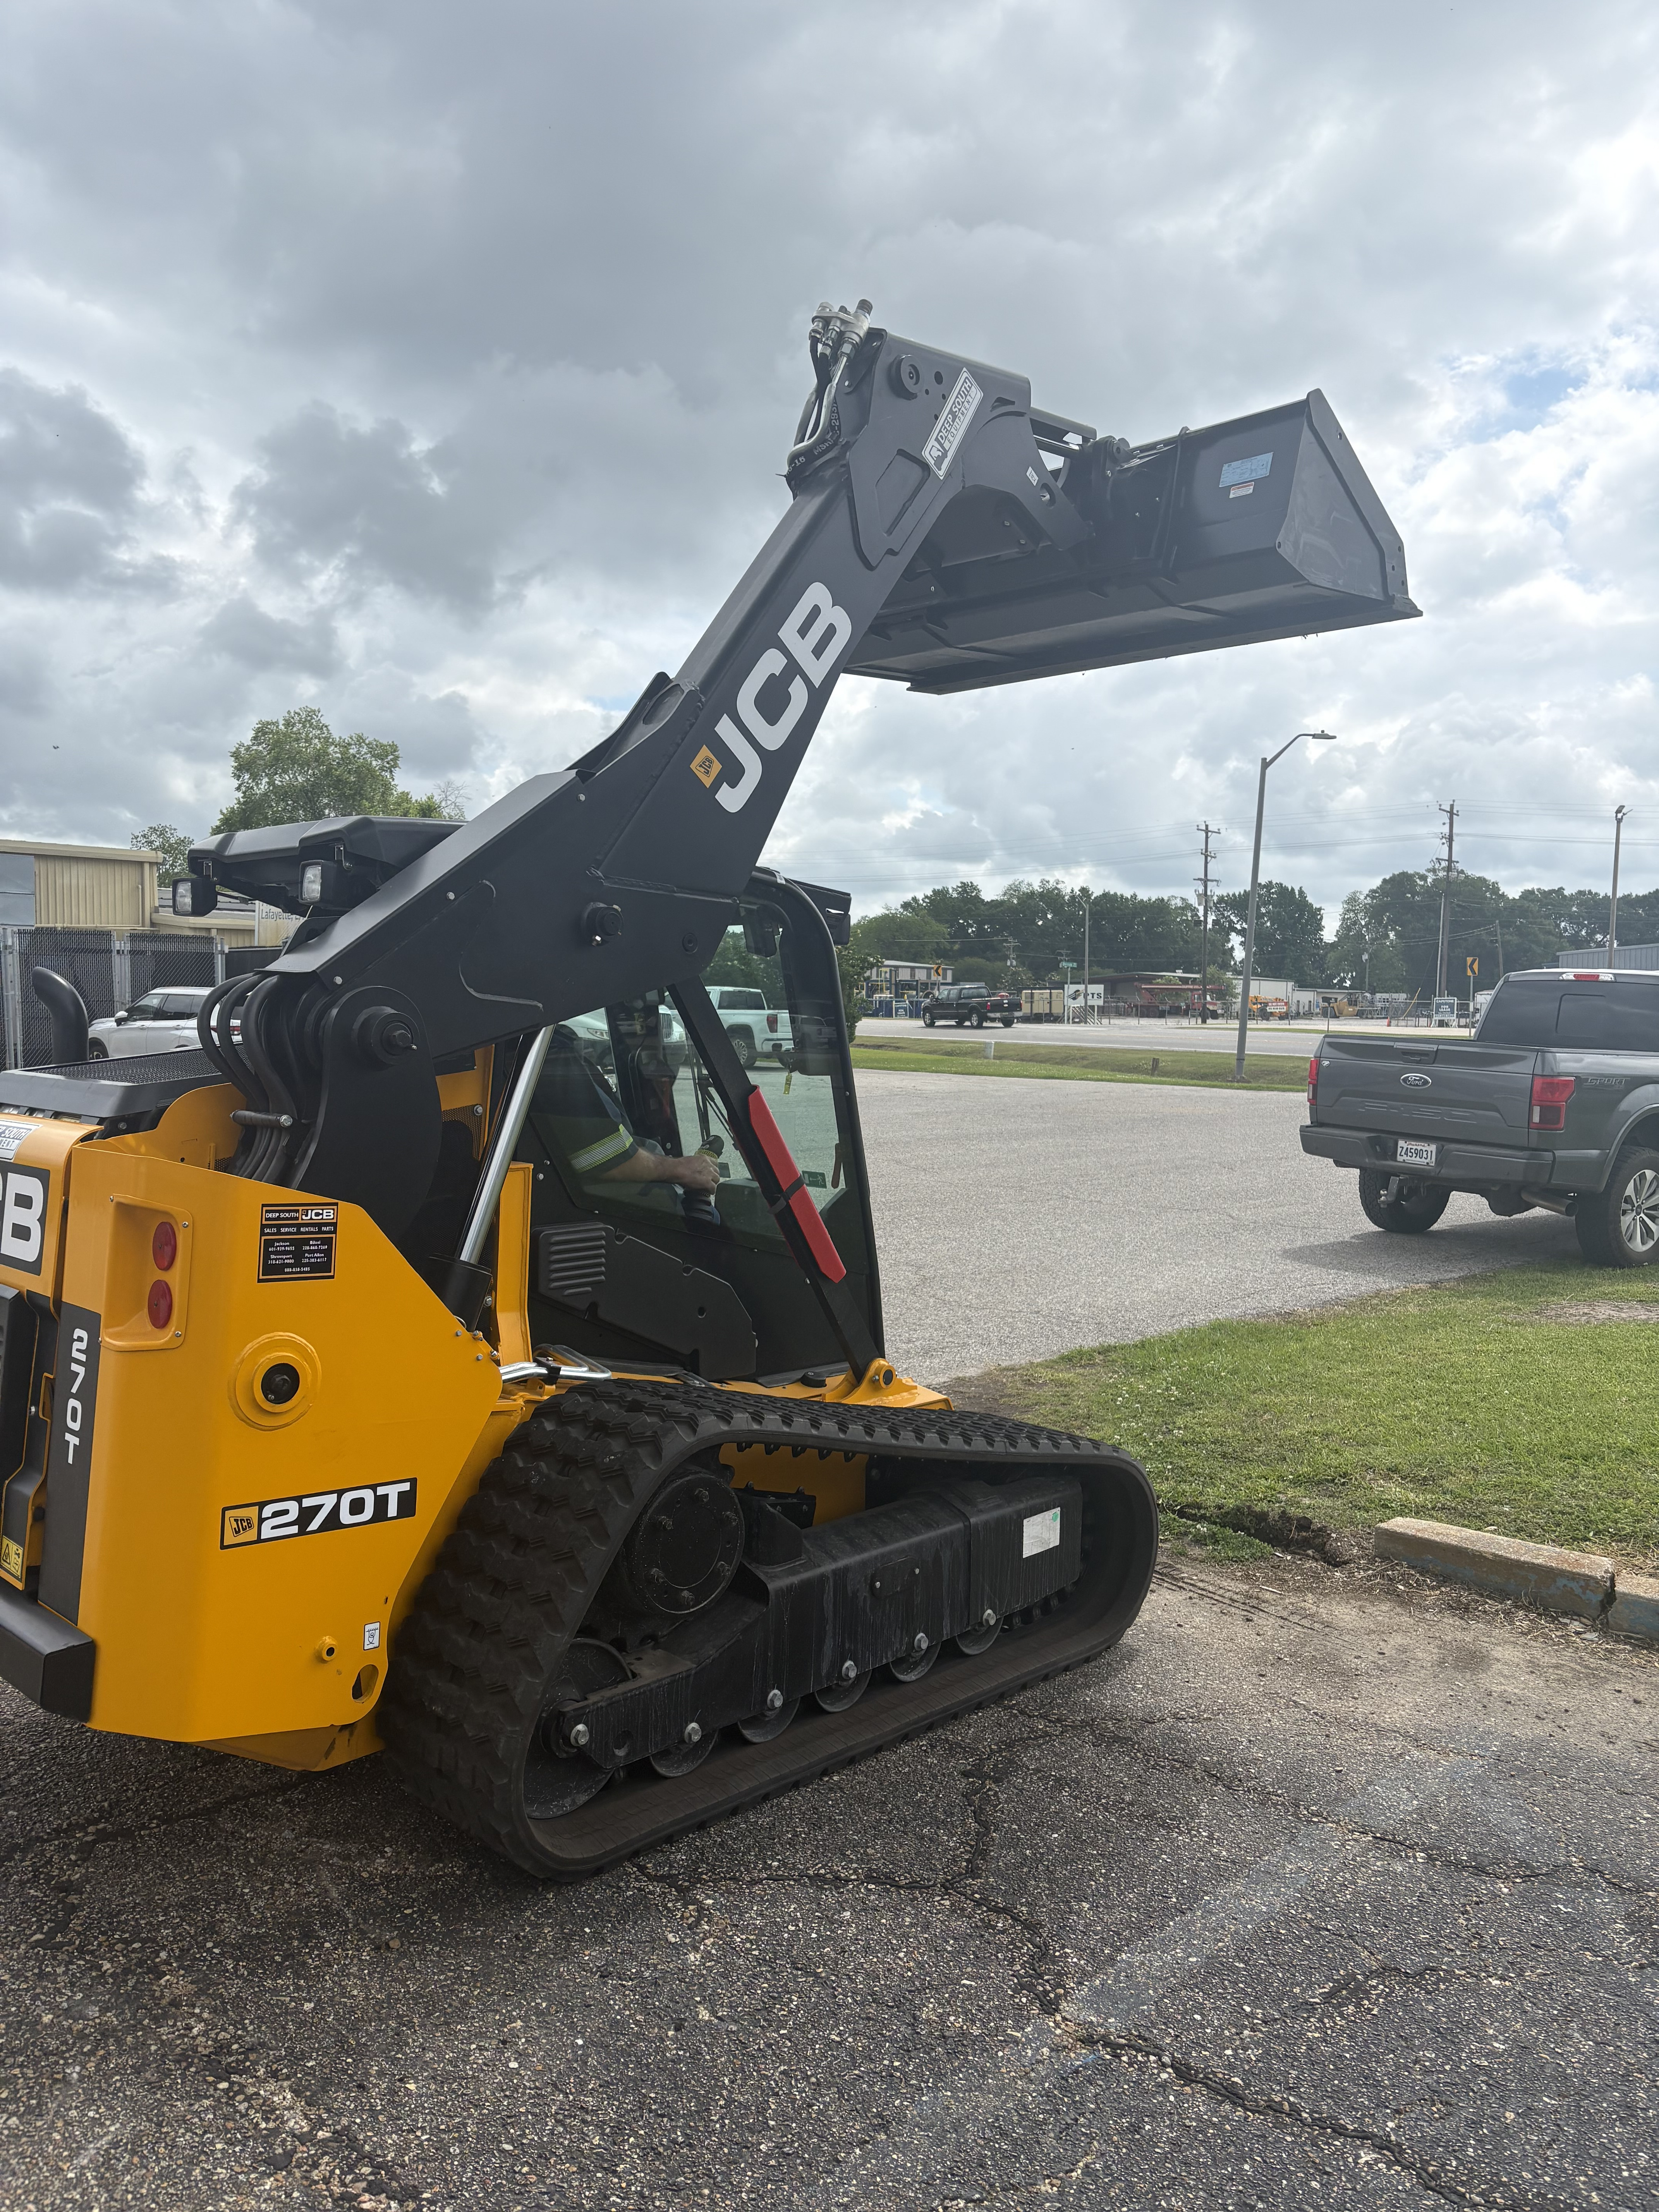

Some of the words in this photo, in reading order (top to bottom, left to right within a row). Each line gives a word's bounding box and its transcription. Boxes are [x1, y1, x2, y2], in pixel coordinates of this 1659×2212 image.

[938, 414, 953, 444] DEEP
[952, 378, 972, 416] SOUTH
[947, 393, 973, 444] EQUIPMENT
[714, 582, 852, 813] JCB
[698, 757, 713, 775] JCB
[1407, 1076, 1424, 1085] Ford
[1583, 1078, 1630, 1086] SPORT
[1399, 1146, 1432, 1161] Z459031
[0, 1173, 43, 1262] B
[302, 1209, 334, 1219] JCB
[65, 1328, 88, 1464] 270T
[233, 1518, 252, 1535] JCB
[261, 1482, 410, 1539] 270T
